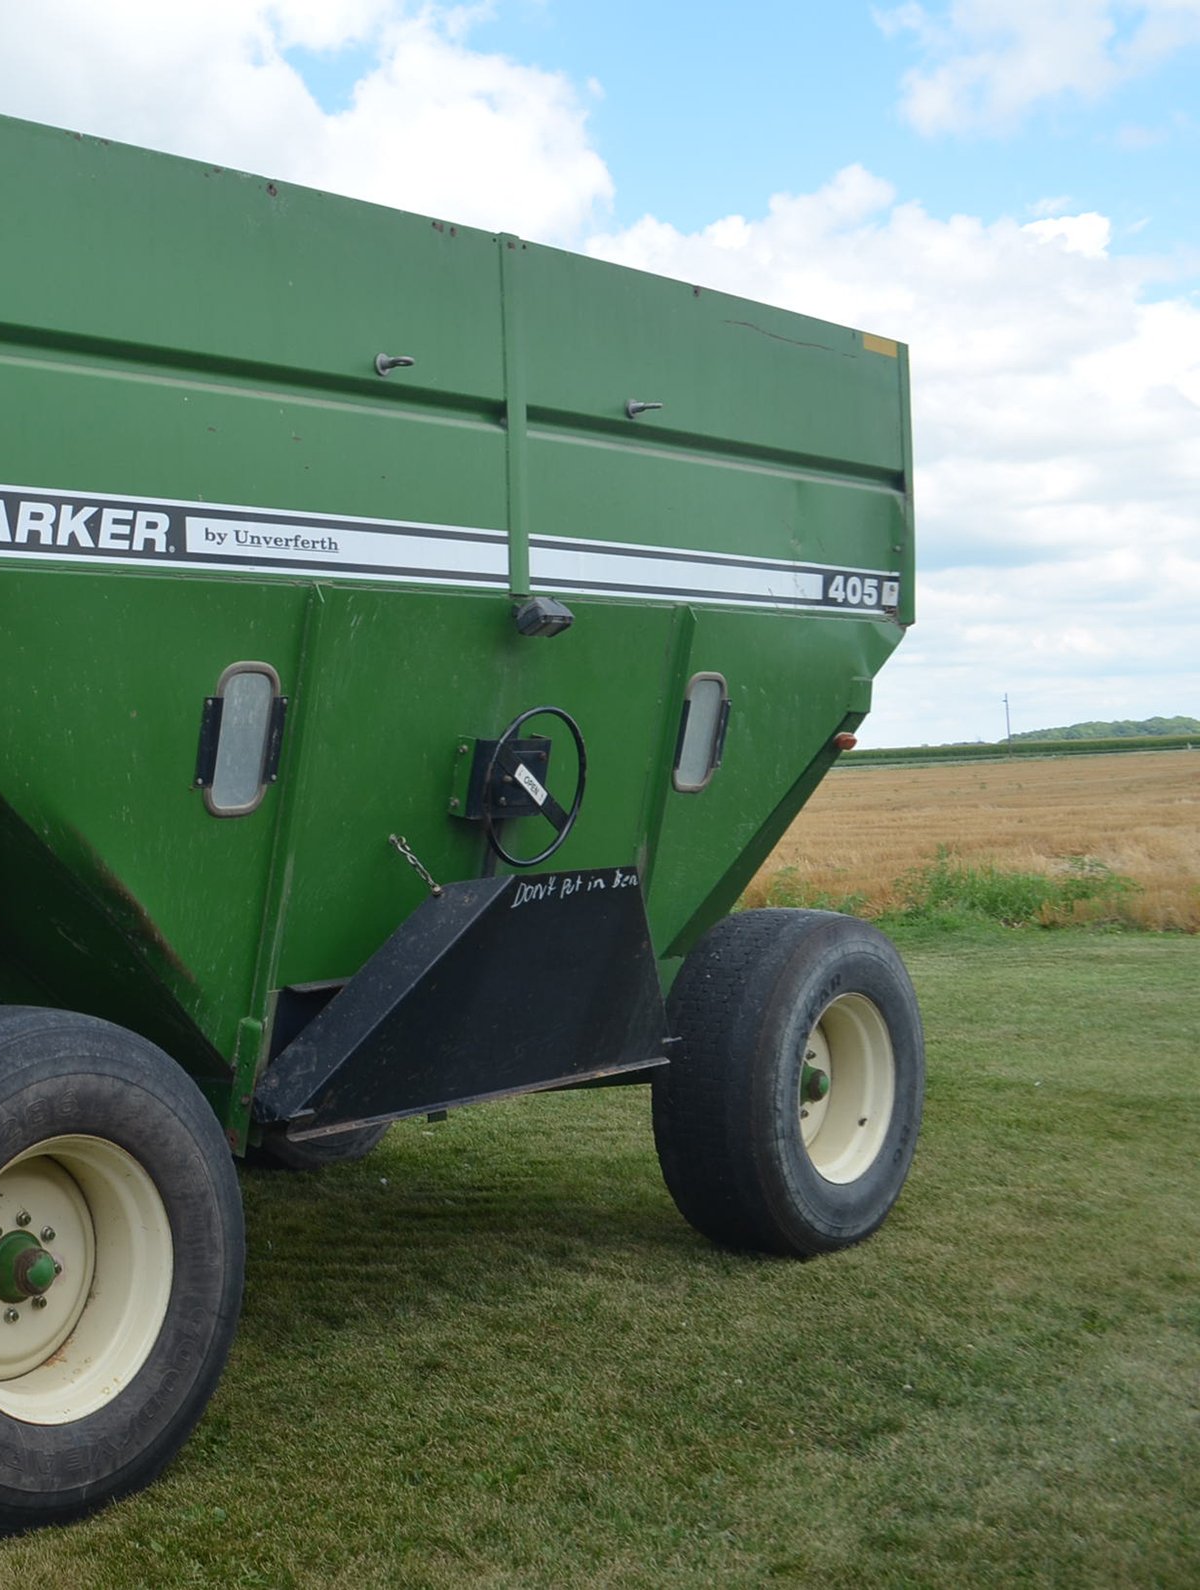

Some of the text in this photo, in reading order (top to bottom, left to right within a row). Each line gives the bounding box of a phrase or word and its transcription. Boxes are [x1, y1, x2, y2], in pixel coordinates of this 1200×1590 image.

[204, 527, 228, 546] by
[234, 529, 339, 553] Unverferth
[828, 575, 878, 606] 405
[523, 776, 540, 796] OPEN
